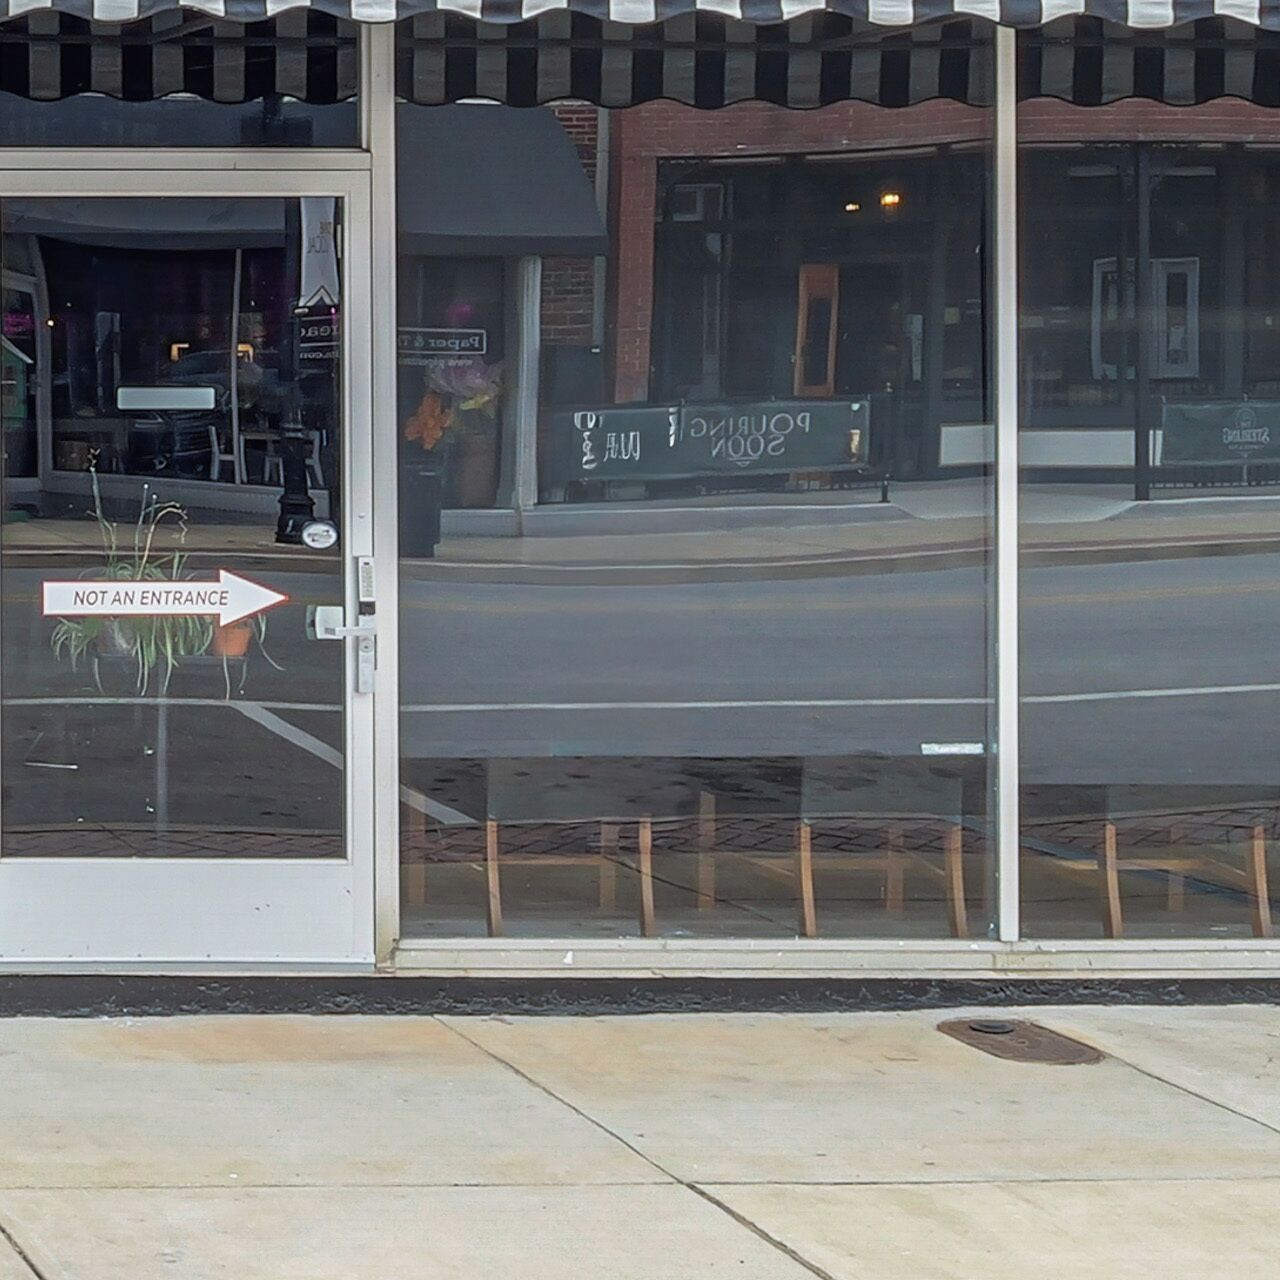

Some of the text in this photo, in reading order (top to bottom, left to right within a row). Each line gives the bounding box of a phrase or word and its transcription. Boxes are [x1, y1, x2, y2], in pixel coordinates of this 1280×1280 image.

[73, 590, 230, 606] NOT AN ENTRANCE
